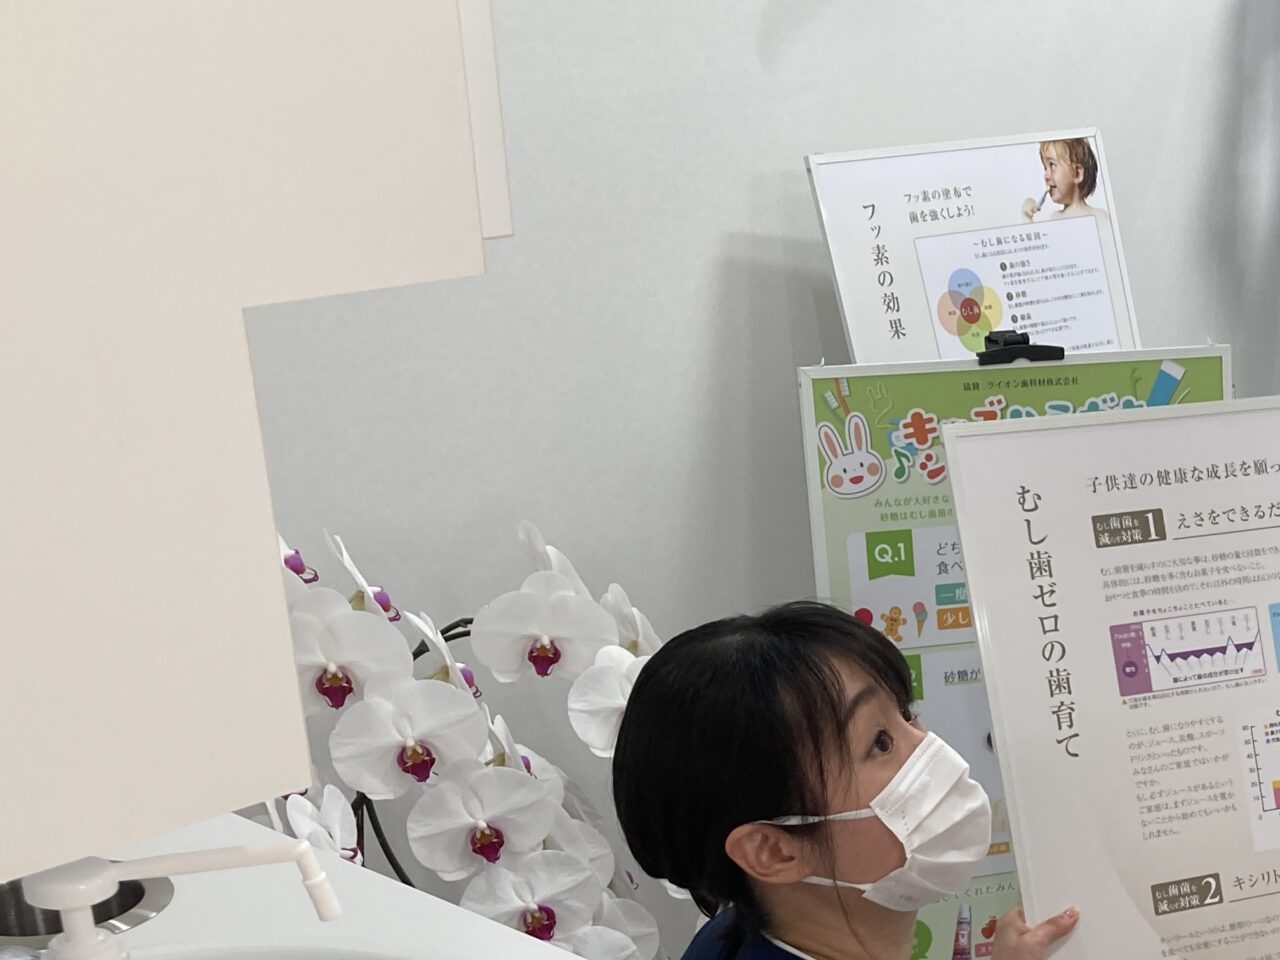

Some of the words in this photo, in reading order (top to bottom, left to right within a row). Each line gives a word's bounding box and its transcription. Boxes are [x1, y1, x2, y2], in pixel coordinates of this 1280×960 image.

[904, 185, 972, 205] フッ素の塗布で
[862, 203, 906, 340] フッ素の効果
[1144, 511, 1160, 541] 1
[874, 543, 906, 564] Q.1
[943, 610, 969, 627] 少し
[1015, 485, 1080, 759] むし歯ゼロの歯育て
[944, 667, 982, 685] 砂糖が
[1200, 877, 1220, 905] 2
